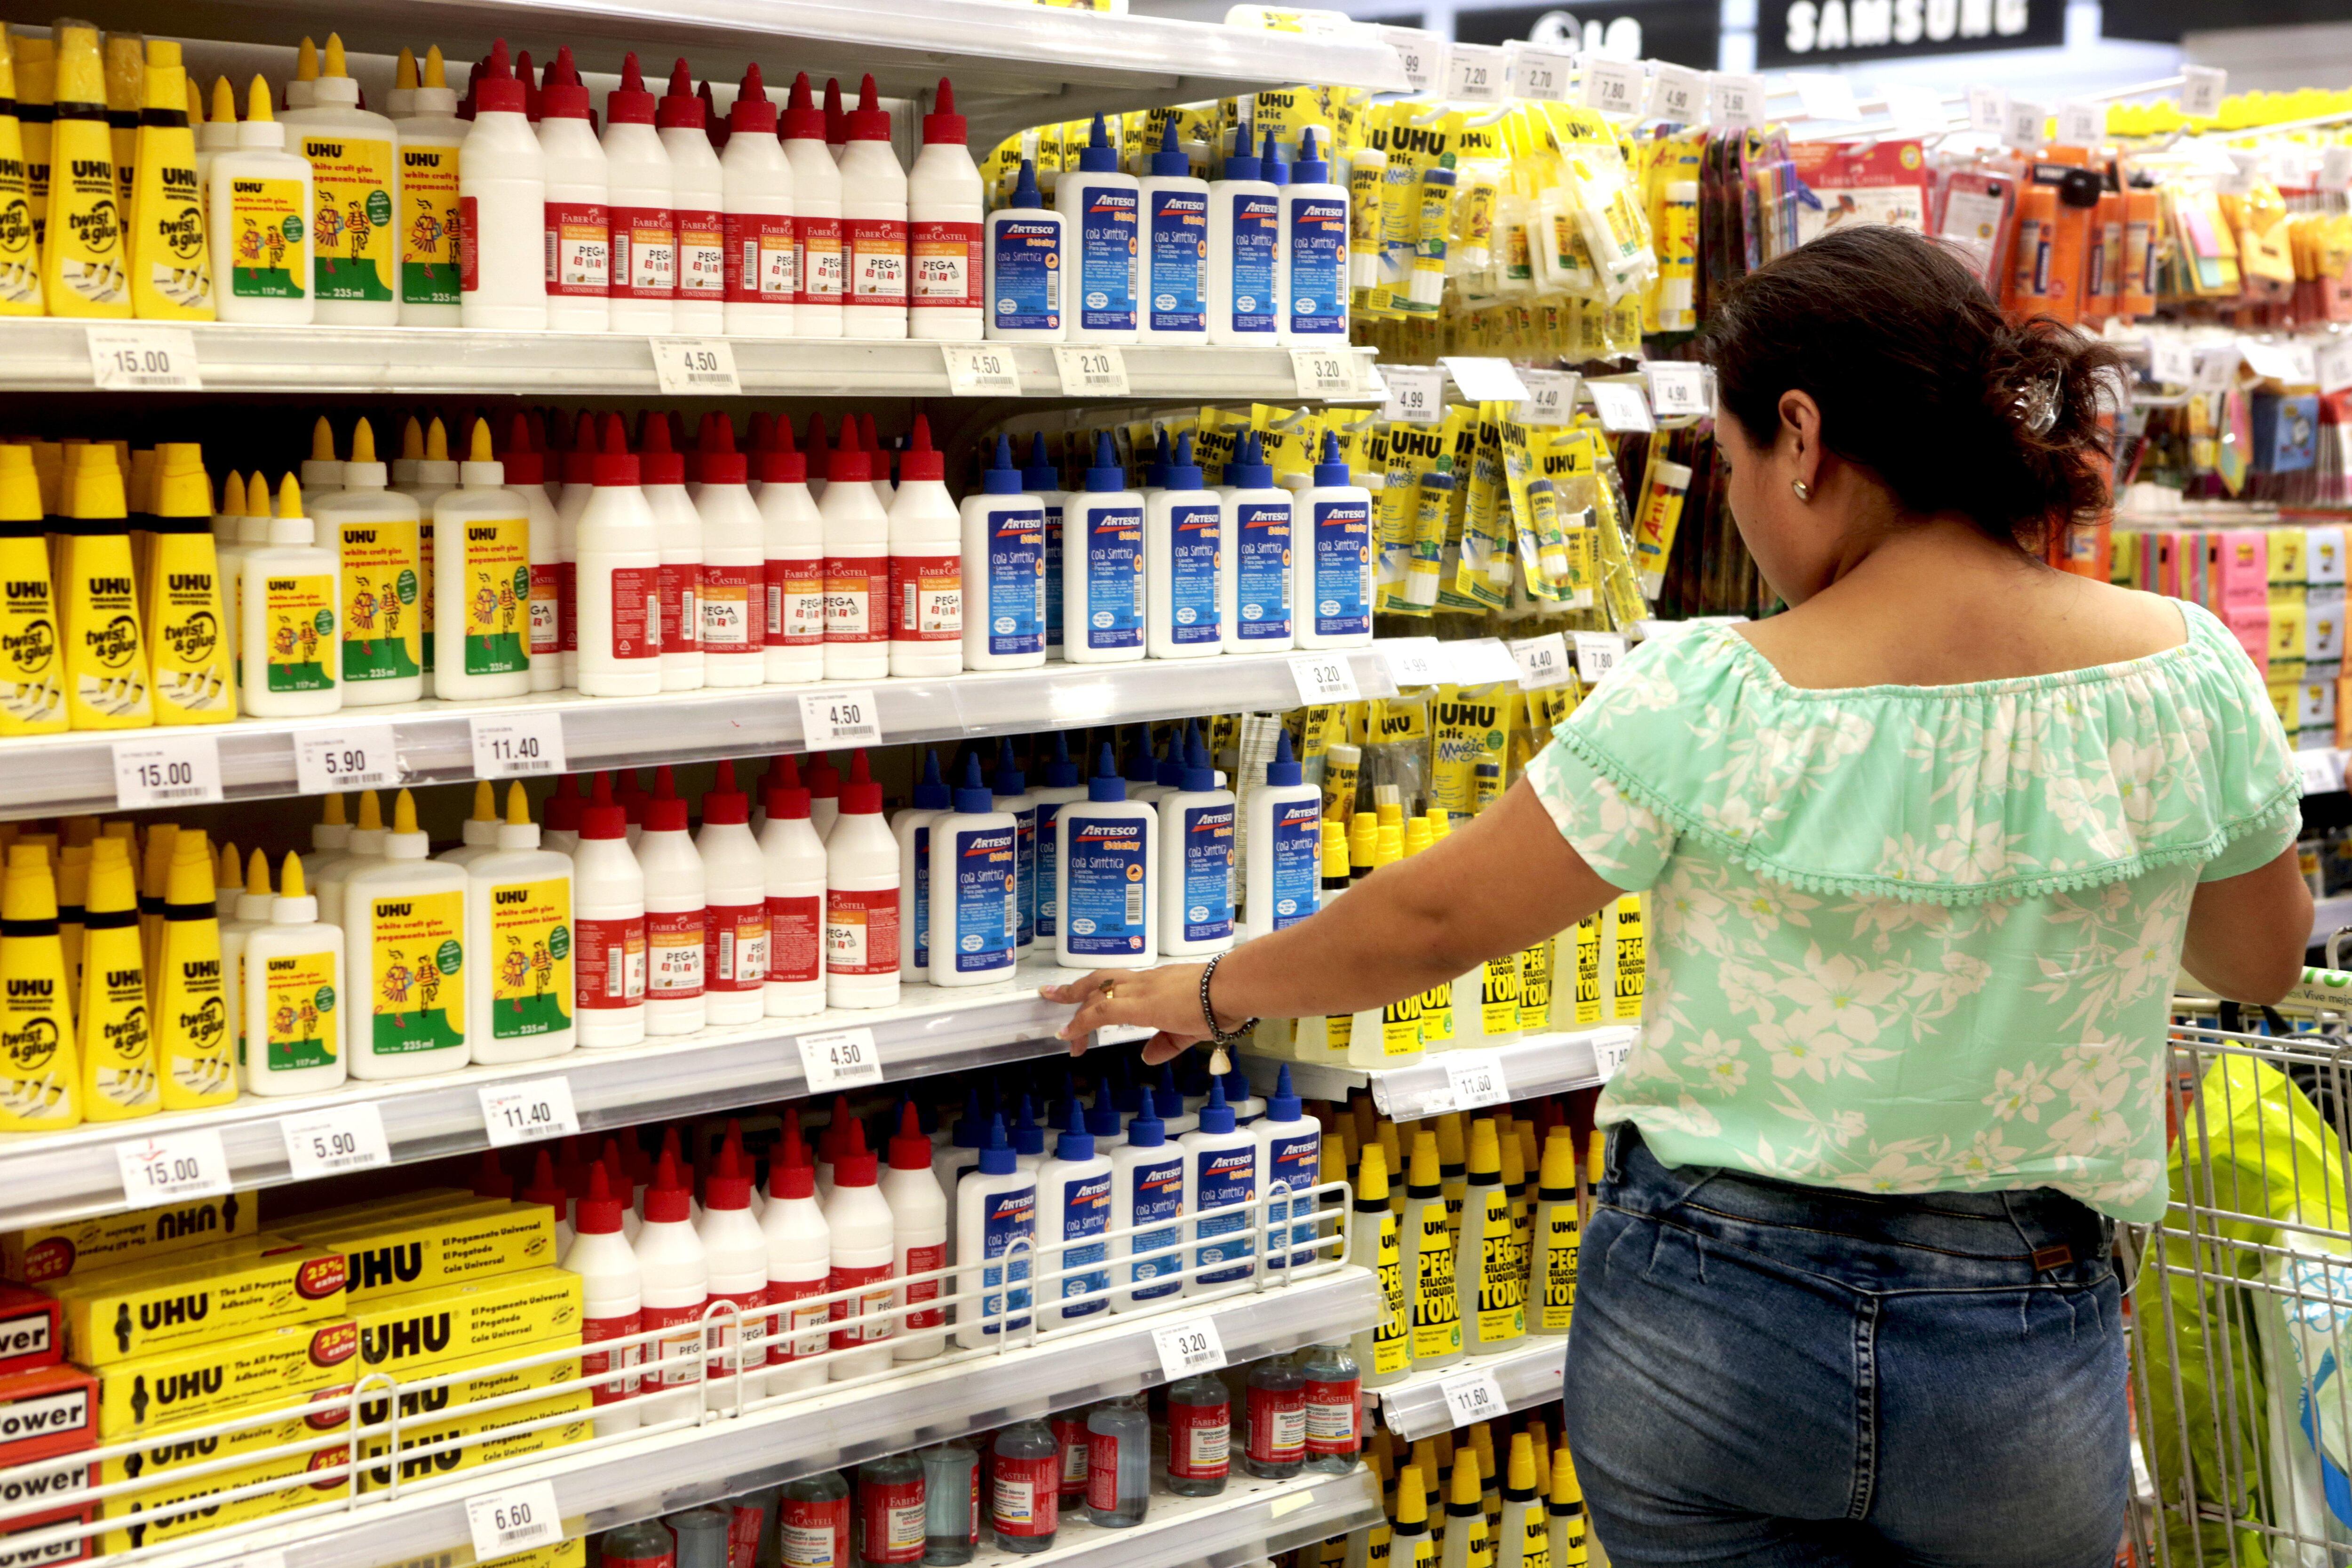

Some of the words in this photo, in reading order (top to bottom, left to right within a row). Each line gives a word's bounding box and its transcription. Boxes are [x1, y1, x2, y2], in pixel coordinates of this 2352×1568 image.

[1786, 0, 2027, 53] SAMSUNG
[1465, 67, 1486, 85] 7.20
[1529, 70, 1551, 88] 2.70
[1603, 80, 1624, 99] 7.80
[1259, 93, 1294, 108] UHU
[1257, 109, 1281, 119] stic
[1392, 126, 1446, 156] UHU
[307, 143, 342, 158] UHU
[405, 153, 440, 167] UHU
[1390, 153, 1413, 165] stic
[72, 160, 112, 179] UHU
[162, 167, 197, 184] UHU
[1353, 170, 1377, 181] UHU
[234, 182, 262, 193] UHU
[1424, 189, 1448, 199] UHU
[1096, 195, 1136, 206] ARTESCO
[1164, 199, 1204, 210] ARTESCO
[1246, 202, 1277, 213] ARTESCO
[1303, 206, 1343, 217] ARTESCO
[1008, 224, 1054, 234] ARTESCO
[1027, 239, 1056, 248] Sticky
[579, 247, 605, 257] PEGA
[871, 260, 899, 269] PEGA
[923, 261, 954, 270] PEGA
[113, 350, 170, 373] 15.00
[685, 352, 717, 371] 4.50
[971, 356, 1000, 374] 4.50
[1081, 355, 1110, 373] 2.10
[1315, 360, 1339, 377] 3.20
[1400, 391, 1423, 407] 4.99
[1537, 391, 1557, 406] 4.40
[1668, 386, 1687, 401] 4.90
[1392, 431, 1442, 458] UHU
[1389, 457, 1411, 468] stic
[1543, 454, 1575, 474] UHU
[1101, 516, 1140, 525] ARTESCO
[1183, 513, 1219, 524] ARTESCO
[1249, 511, 1288, 521] ARTESCO
[1327, 509, 1366, 520] ARTESCO
[1001, 519, 1041, 529] ARTESCO
[344, 530, 376, 543] UHU
[469, 528, 496, 540] UHU
[6, 582, 47, 597] UHU
[89, 578, 130, 594] UHU
[169, 575, 211, 590] UHU
[269, 581, 295, 591] UHU
[824, 597, 855, 606] PEGA
[1530, 651, 1551, 669] 4.40
[1592, 653, 1613, 668] 7.80
[1317, 666, 1340, 683] 3.20
[831, 706, 860, 724] 4.50
[1310, 709, 1328, 722] UHU
[1439, 703, 1495, 727] UHU
[1308, 724, 1320, 734] stic
[1382, 716, 1411, 733] UHU
[1438, 729, 1463, 739] stic
[492, 737, 539, 759] 11.40
[326, 750, 365, 773] 5.90
[138, 762, 191, 786] 15.00
[1478, 781, 1496, 790] UHU
[1197, 814, 1232, 826] ARTESCO
[1285, 808, 1318, 820] ARTESCO
[1081, 826, 1137, 836] ARTESCO
[970, 838, 1012, 849] ARTESCO
[496, 891, 527, 904] UHU
[376, 903, 411, 917] UHU
[1619, 912, 1640, 924] UHU
[667, 951, 697, 962] PEGA
[183, 961, 220, 977] UHU
[269, 960, 295, 970] UHU
[7, 980, 53, 995] UHU
[2304, 990, 2325, 1001] Vive
[831, 1044, 860, 1064] 4.50
[1461, 1075, 1491, 1094] 11.60
[503, 1103, 551, 1128] 11.40
[314, 1132, 356, 1158] 5.90
[1282, 1142, 1317, 1156] ARTESCO
[1211, 1154, 1252, 1169] ARTESCO
[145, 1157, 199, 1186] 15.00
[1145, 1167, 1182, 1182] ARTESCO
[1076, 1182, 1110, 1197] ARTESCO
[998, 1195, 1034, 1211] ARTESCO
[157, 1204, 216, 1241] UHU
[1552, 1221, 1577, 1233] UHU
[452, 1230, 499, 1246] Pegamento
[501, 1221, 540, 1236] Universal
[452, 1245, 493, 1260] Pegatodo
[307, 1259, 343, 1281] 25%
[444, 1265, 462, 1274] Cola
[465, 1256, 504, 1270] Universal
[220, 1287, 237, 1297] The
[240, 1283, 252, 1293] All
[255, 1277, 298, 1291] Purpose
[315, 1274, 343, 1289] extra
[1423, 1286, 1454, 1298] LIQUIDA
[221, 1297, 263, 1310] Adhesive
[480, 1299, 527, 1315] Pegamento
[529, 1290, 569, 1304] Universal
[141, 1293, 207, 1330] UHU
[480, 1314, 521, 1329] Pegatodo
[321, 1328, 355, 1348] 25%
[361, 1312, 451, 1365] UHU
[471, 1334, 490, 1343] Cola
[492, 1325, 532, 1338] Universal
[328, 1342, 355, 1356] extra
[1179, 1333, 1207, 1354] 3.20
[234, 1368, 277, 1382] Adhesive
[478, 1375, 519, 1390] Pegatodo
[156, 1365, 222, 1404] UHU
[1458, 1387, 1488, 1409] 11.60
[0, 1405, 82, 1433] ower
[230, 1427, 272, 1443] Adhesive
[483, 1453, 501, 1462] Cola
[503, 1442, 543, 1457] Universal
[496, 1503, 531, 1529] 6.60
